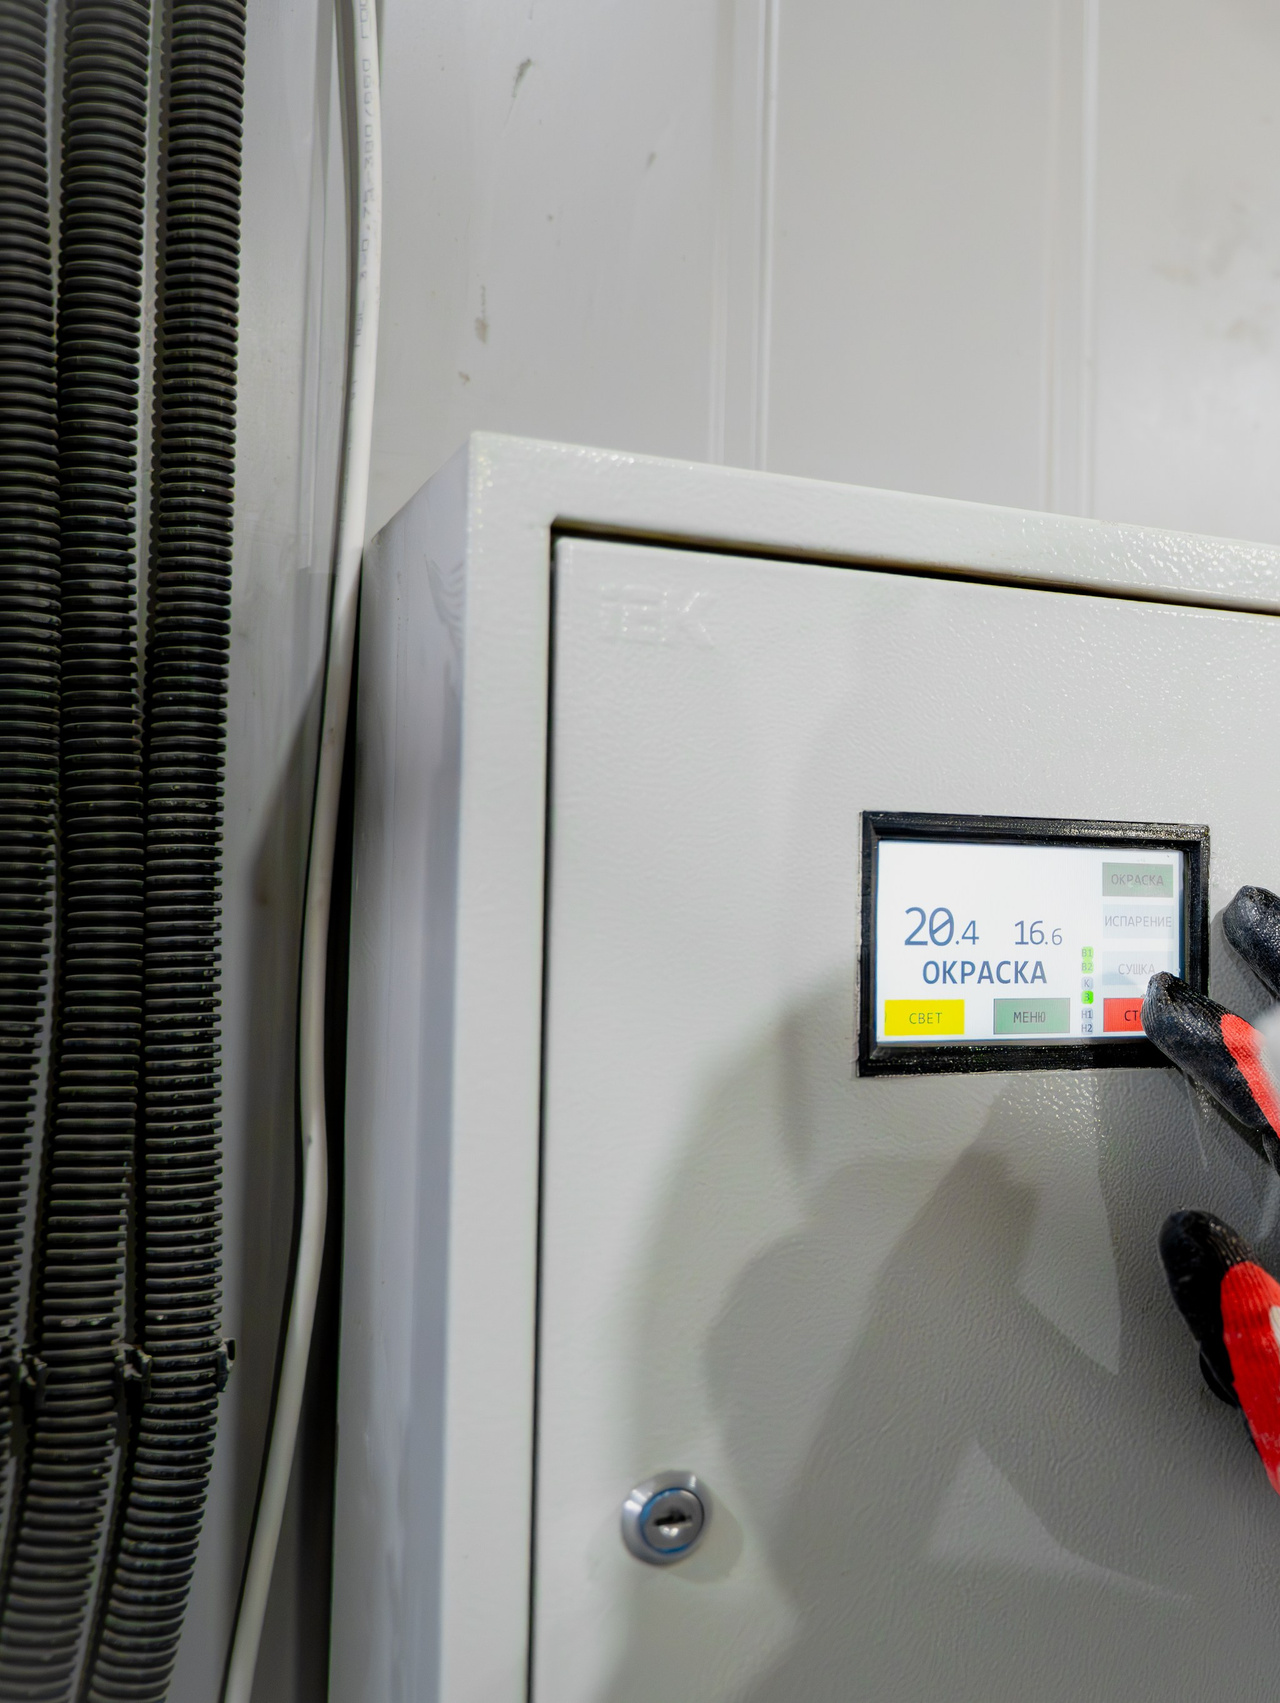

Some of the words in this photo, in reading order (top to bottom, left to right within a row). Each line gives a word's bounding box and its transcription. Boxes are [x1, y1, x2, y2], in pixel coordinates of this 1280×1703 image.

[1111, 874, 1164, 886] ОКРАСКА
[904, 906, 980, 946] 20.4
[1104, 915, 1172, 928] ИСПАРЕНИЕ
[1014, 920, 1063, 946] 16.6
[922, 960, 1048, 985] ОКРАСКА
[909, 1012, 943, 1025] СВЕТ
[1013, 1011, 1046, 1023] МЕНЮ
[1124, 1010, 1141, 1021] СТ
